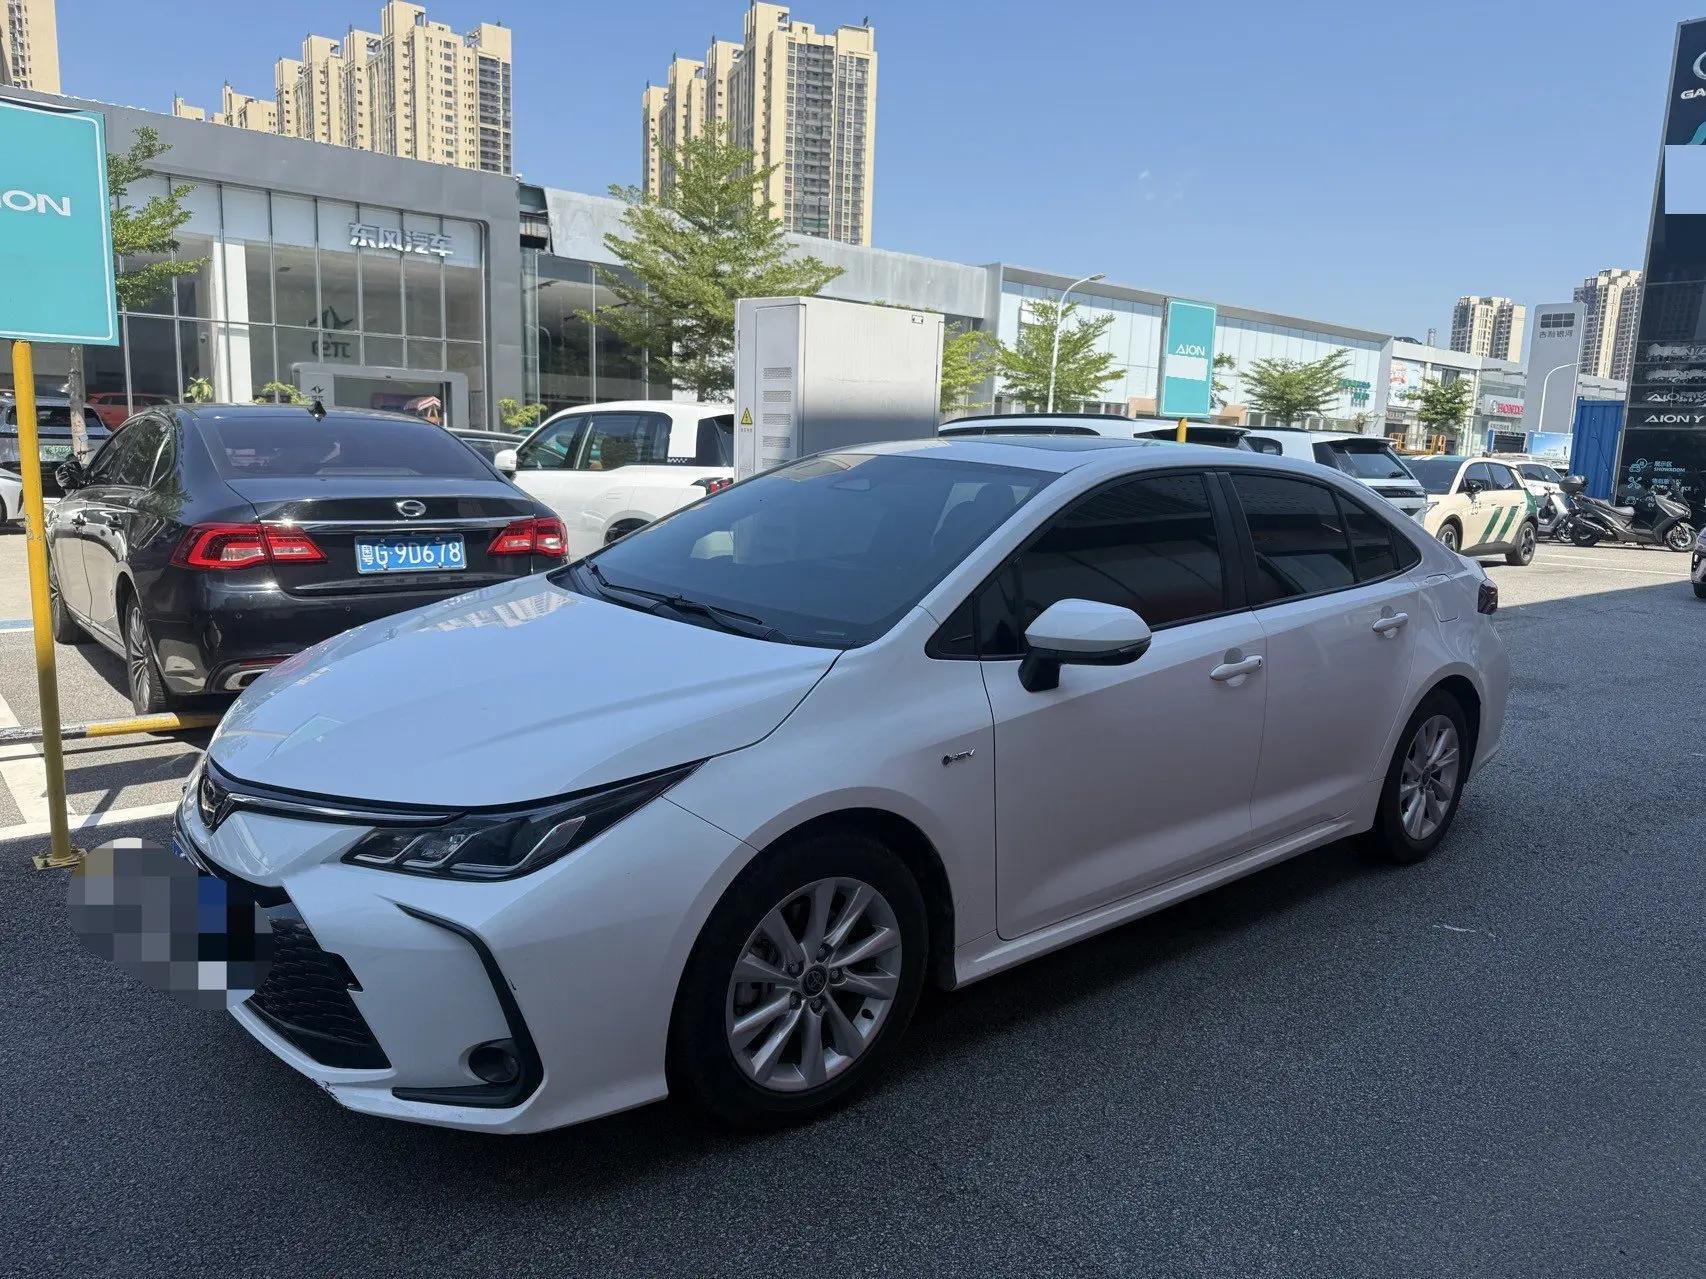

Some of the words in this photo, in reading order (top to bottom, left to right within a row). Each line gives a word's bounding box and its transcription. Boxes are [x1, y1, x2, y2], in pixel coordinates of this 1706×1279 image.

[1681, 88, 1706, 100] GA
[0, 190, 71, 216] ON
[349, 223, 453, 257] 东风汽车
[1175, 344, 1205, 356] AION
[1644, 414, 1690, 423] AION
[1694, 415, 1704, 423] Y
